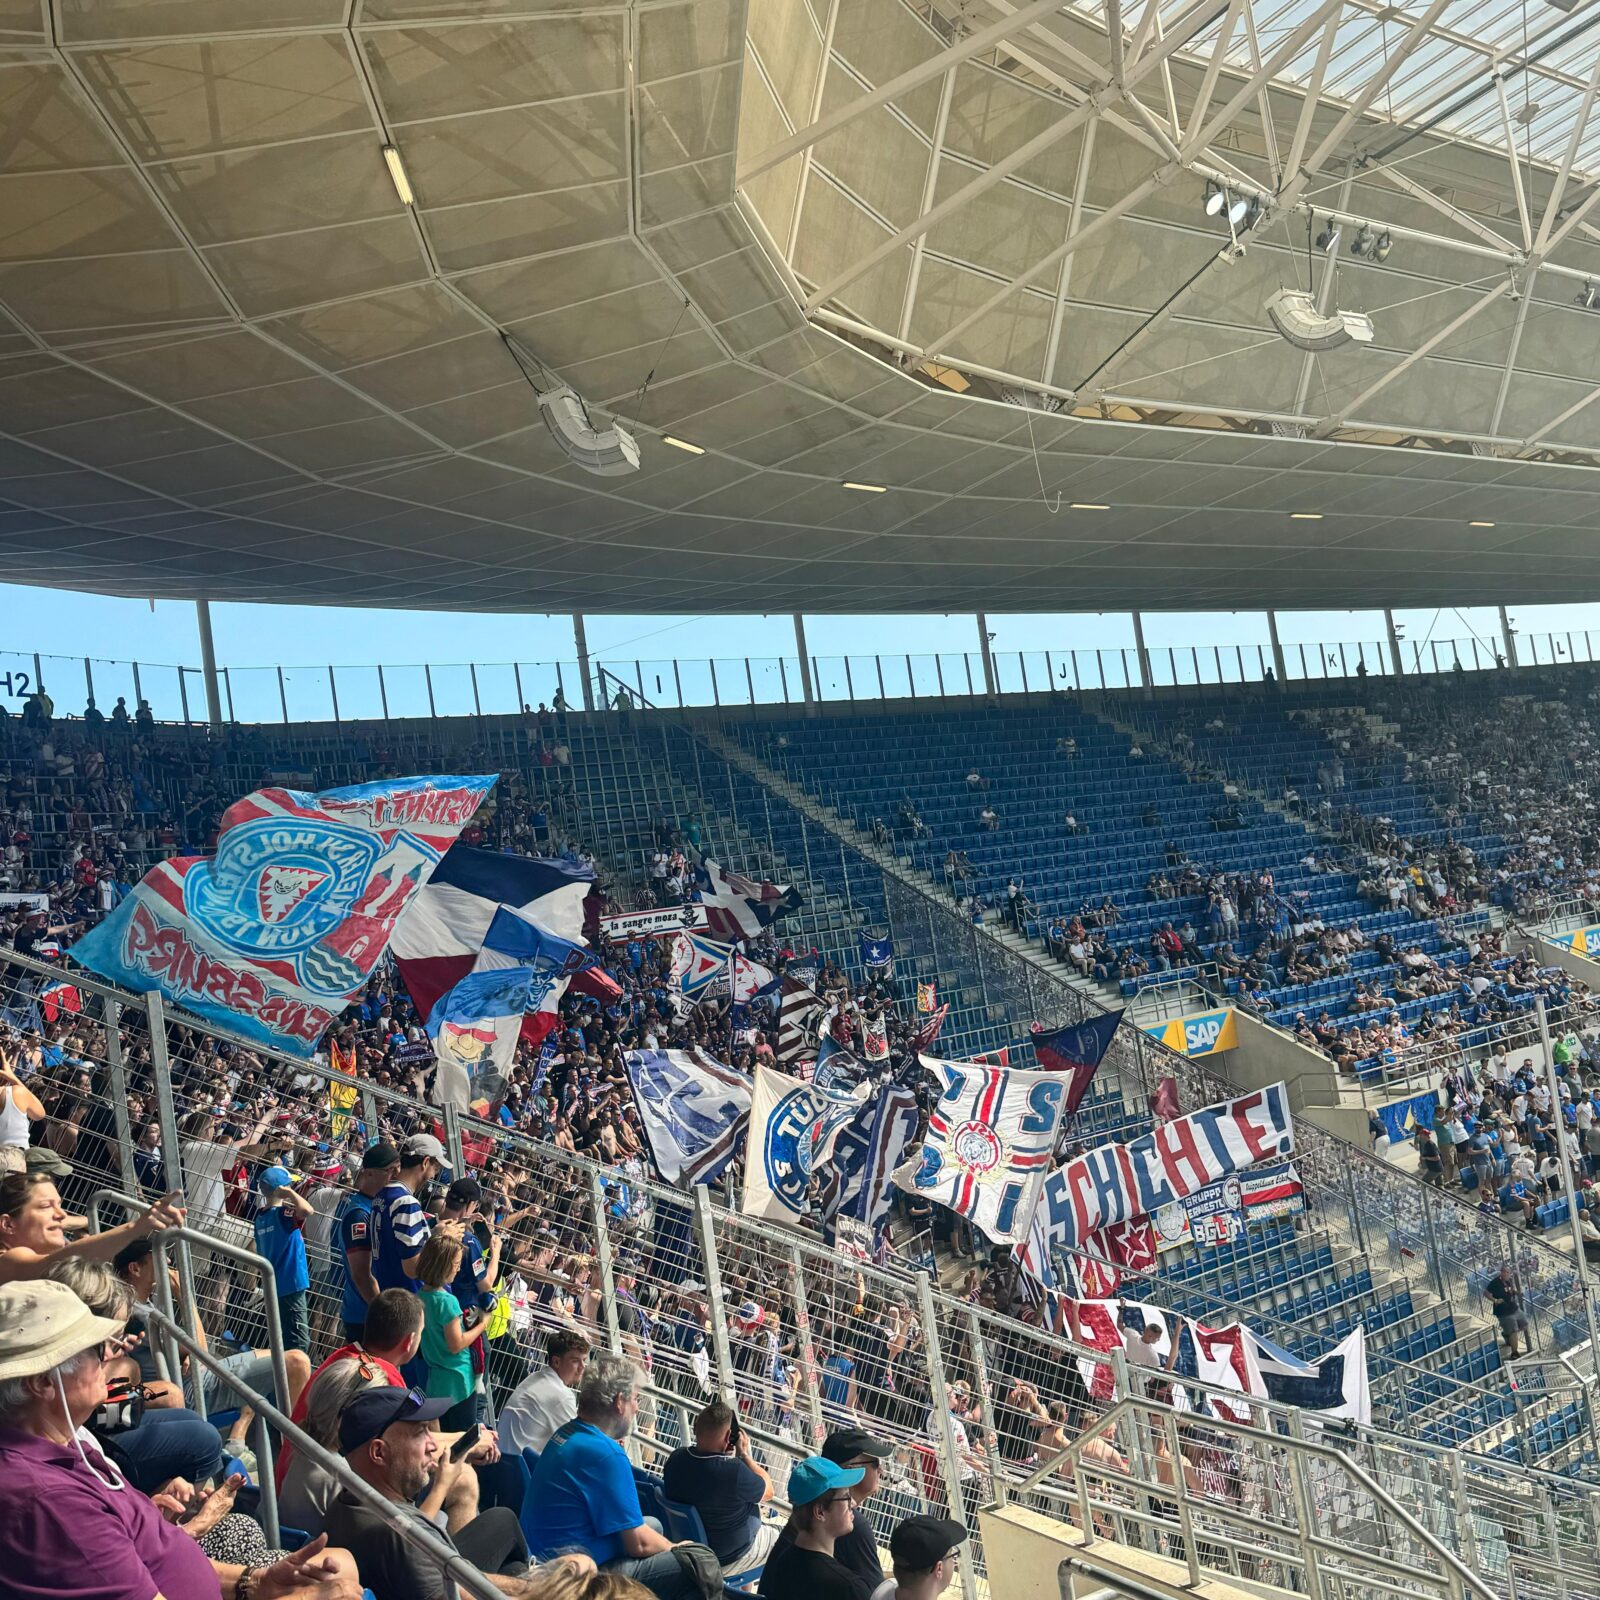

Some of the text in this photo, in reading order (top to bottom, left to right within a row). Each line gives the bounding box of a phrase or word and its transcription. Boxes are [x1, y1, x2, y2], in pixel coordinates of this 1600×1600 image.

[1556, 641, 1565, 655] L
[1327, 653, 1337, 667] K
[1059, 662, 1067, 679] J
[1185, 1020, 1220, 1049] SAP
[1041, 1085, 1291, 1258] SCHICHTE!
